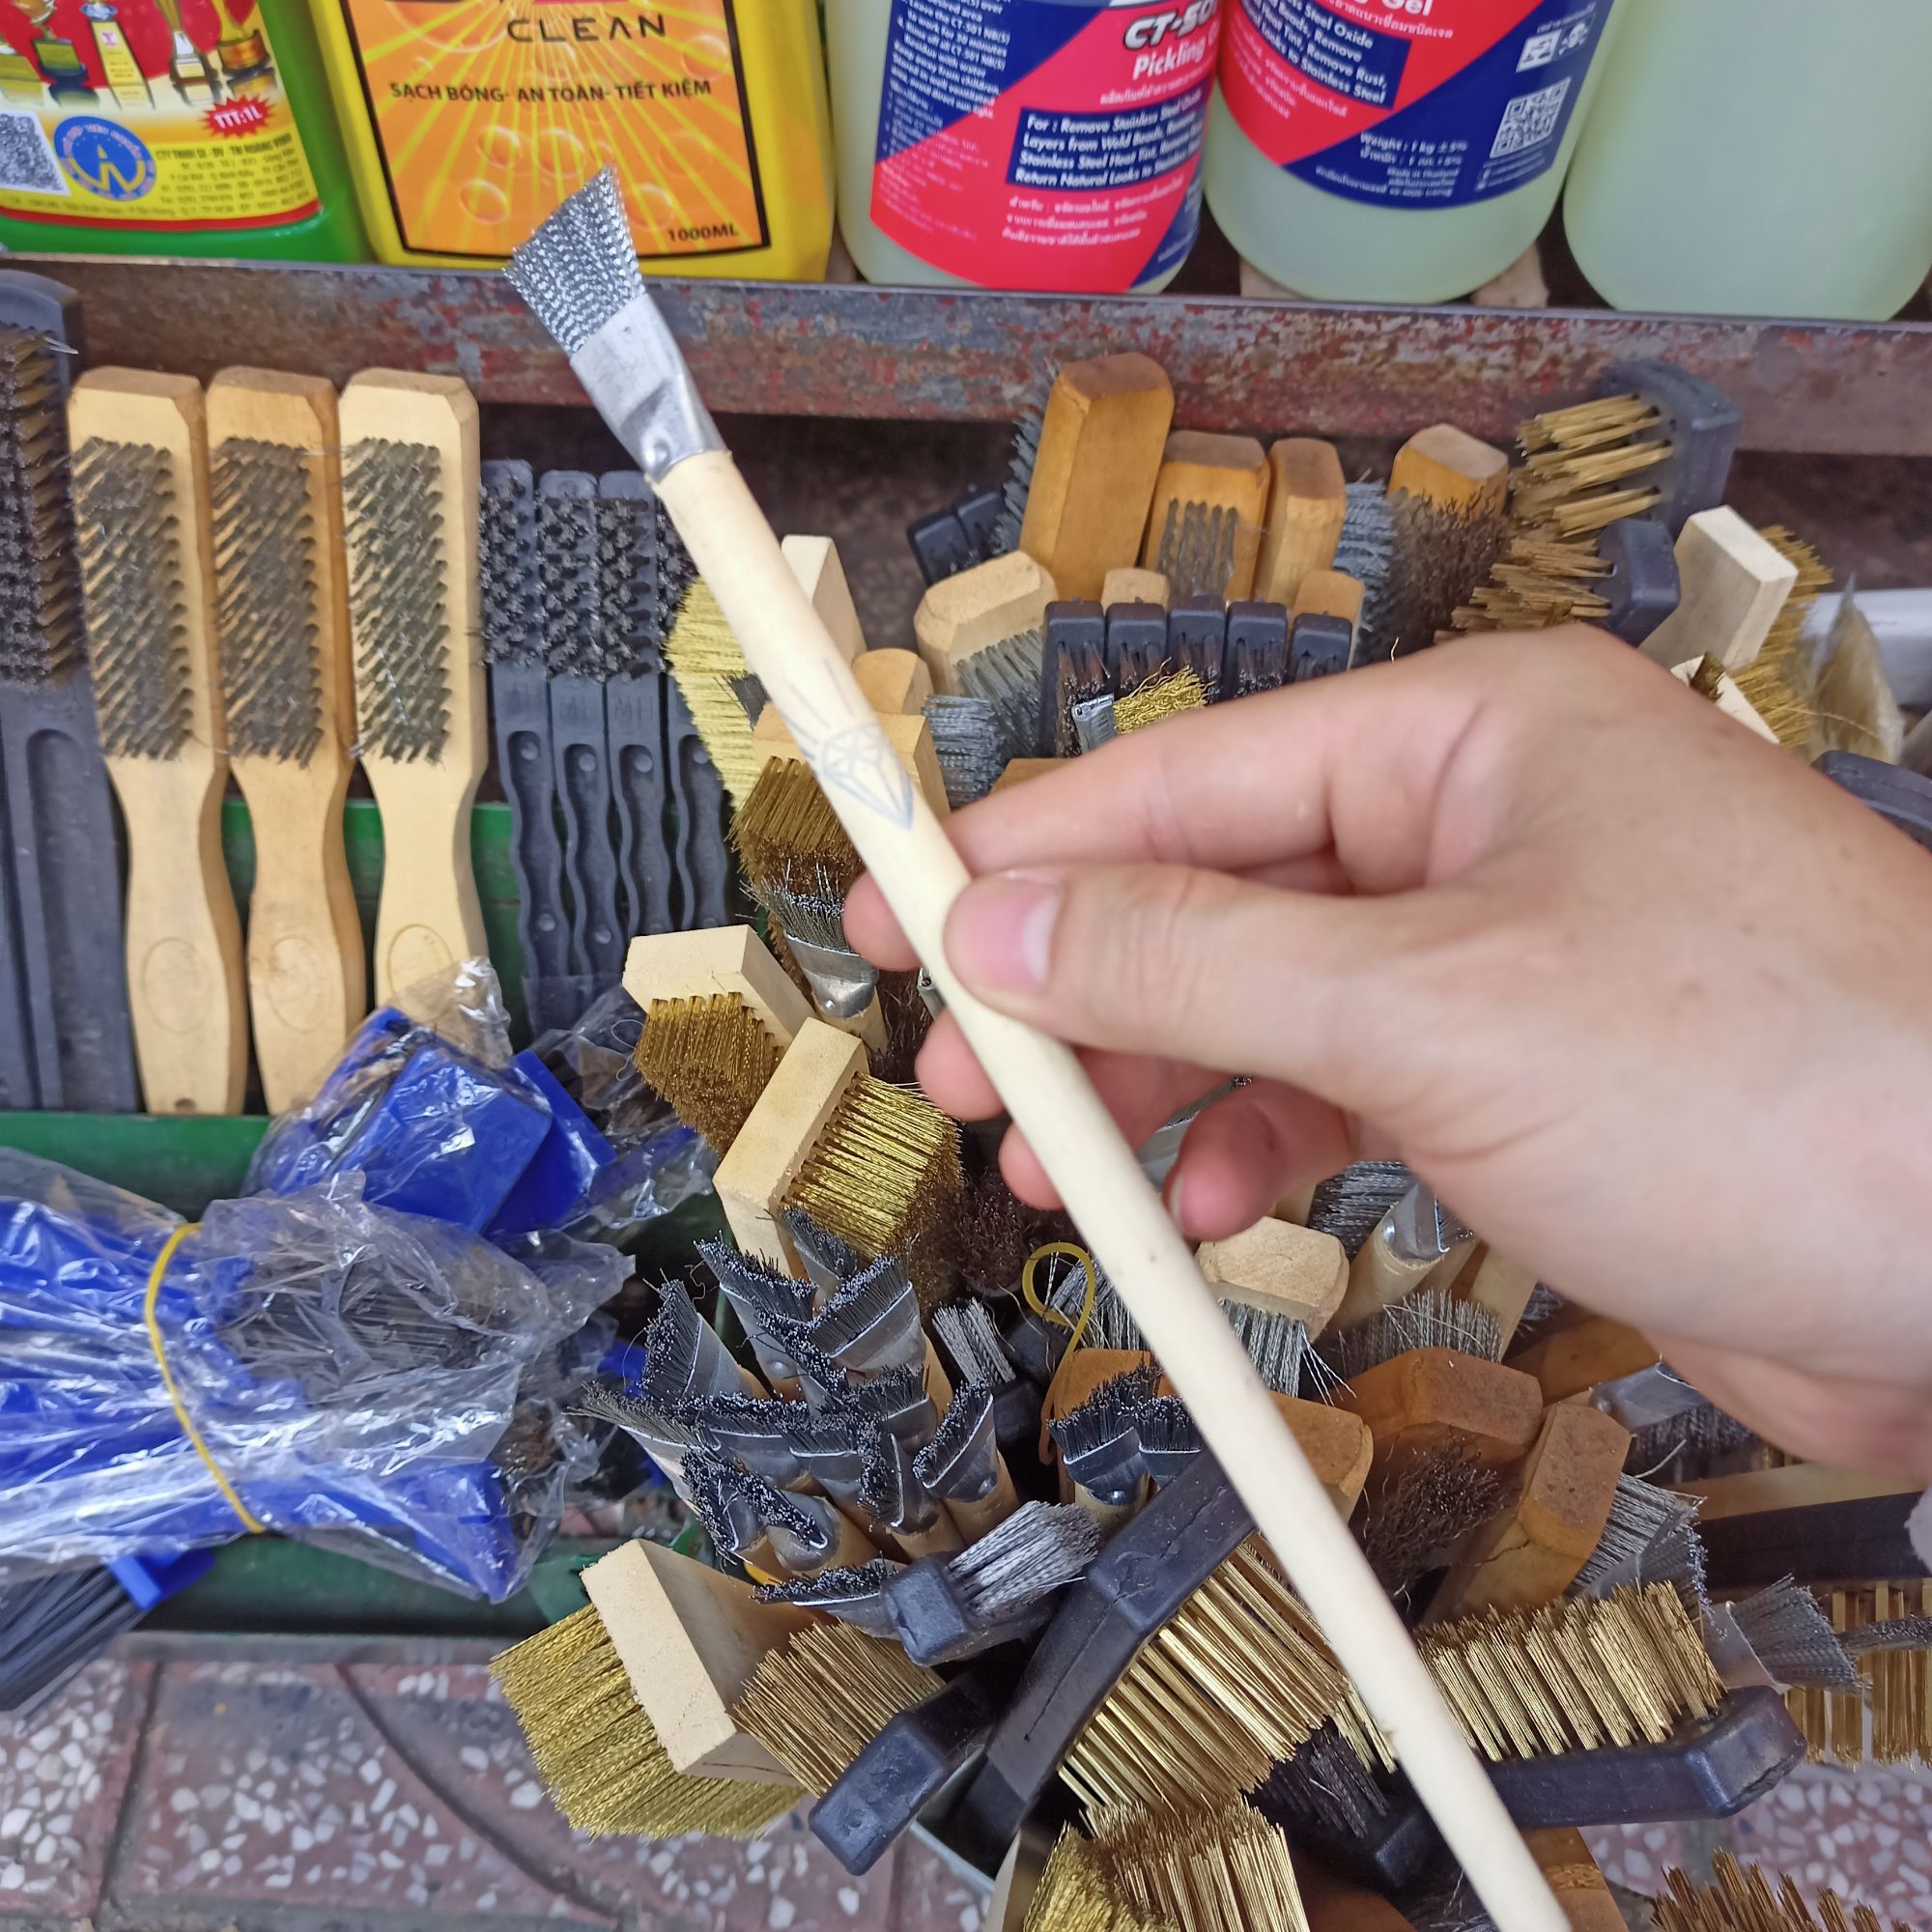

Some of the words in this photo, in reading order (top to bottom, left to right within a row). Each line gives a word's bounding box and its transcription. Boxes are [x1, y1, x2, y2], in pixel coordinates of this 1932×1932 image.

[507, 13, 666, 43] CLEAN
[1304, 3, 1333, 31] Steel
[1333, 21, 1374, 49] Oxide
[1314, 27, 1362, 63] Remove
[1132, 37, 1207, 80] Pickling
[1307, 42, 1353, 77] Remove
[1355, 66, 1388, 90] Rust,
[389, 82, 442, 103] SẠCH
[518, 88, 545, 102] AN
[662, 78, 712, 101] KIỆM
[1300, 57, 1351, 94] Stainless
[1353, 83, 1387, 105] Steel
[1027, 113, 1050, 129] For
[1060, 118, 1111, 133] Remove
[1022, 131, 1065, 154] Layers
[1067, 135, 1099, 152] from
[1360, 130, 1402, 151] Weight
[1019, 150, 1075, 170] Stainless
[1077, 151, 1108, 169] Steel
[1015, 166, 1058, 186] Return
[1059, 168, 1109, 187] Natural
[668, 222, 739, 242] 1000ML
